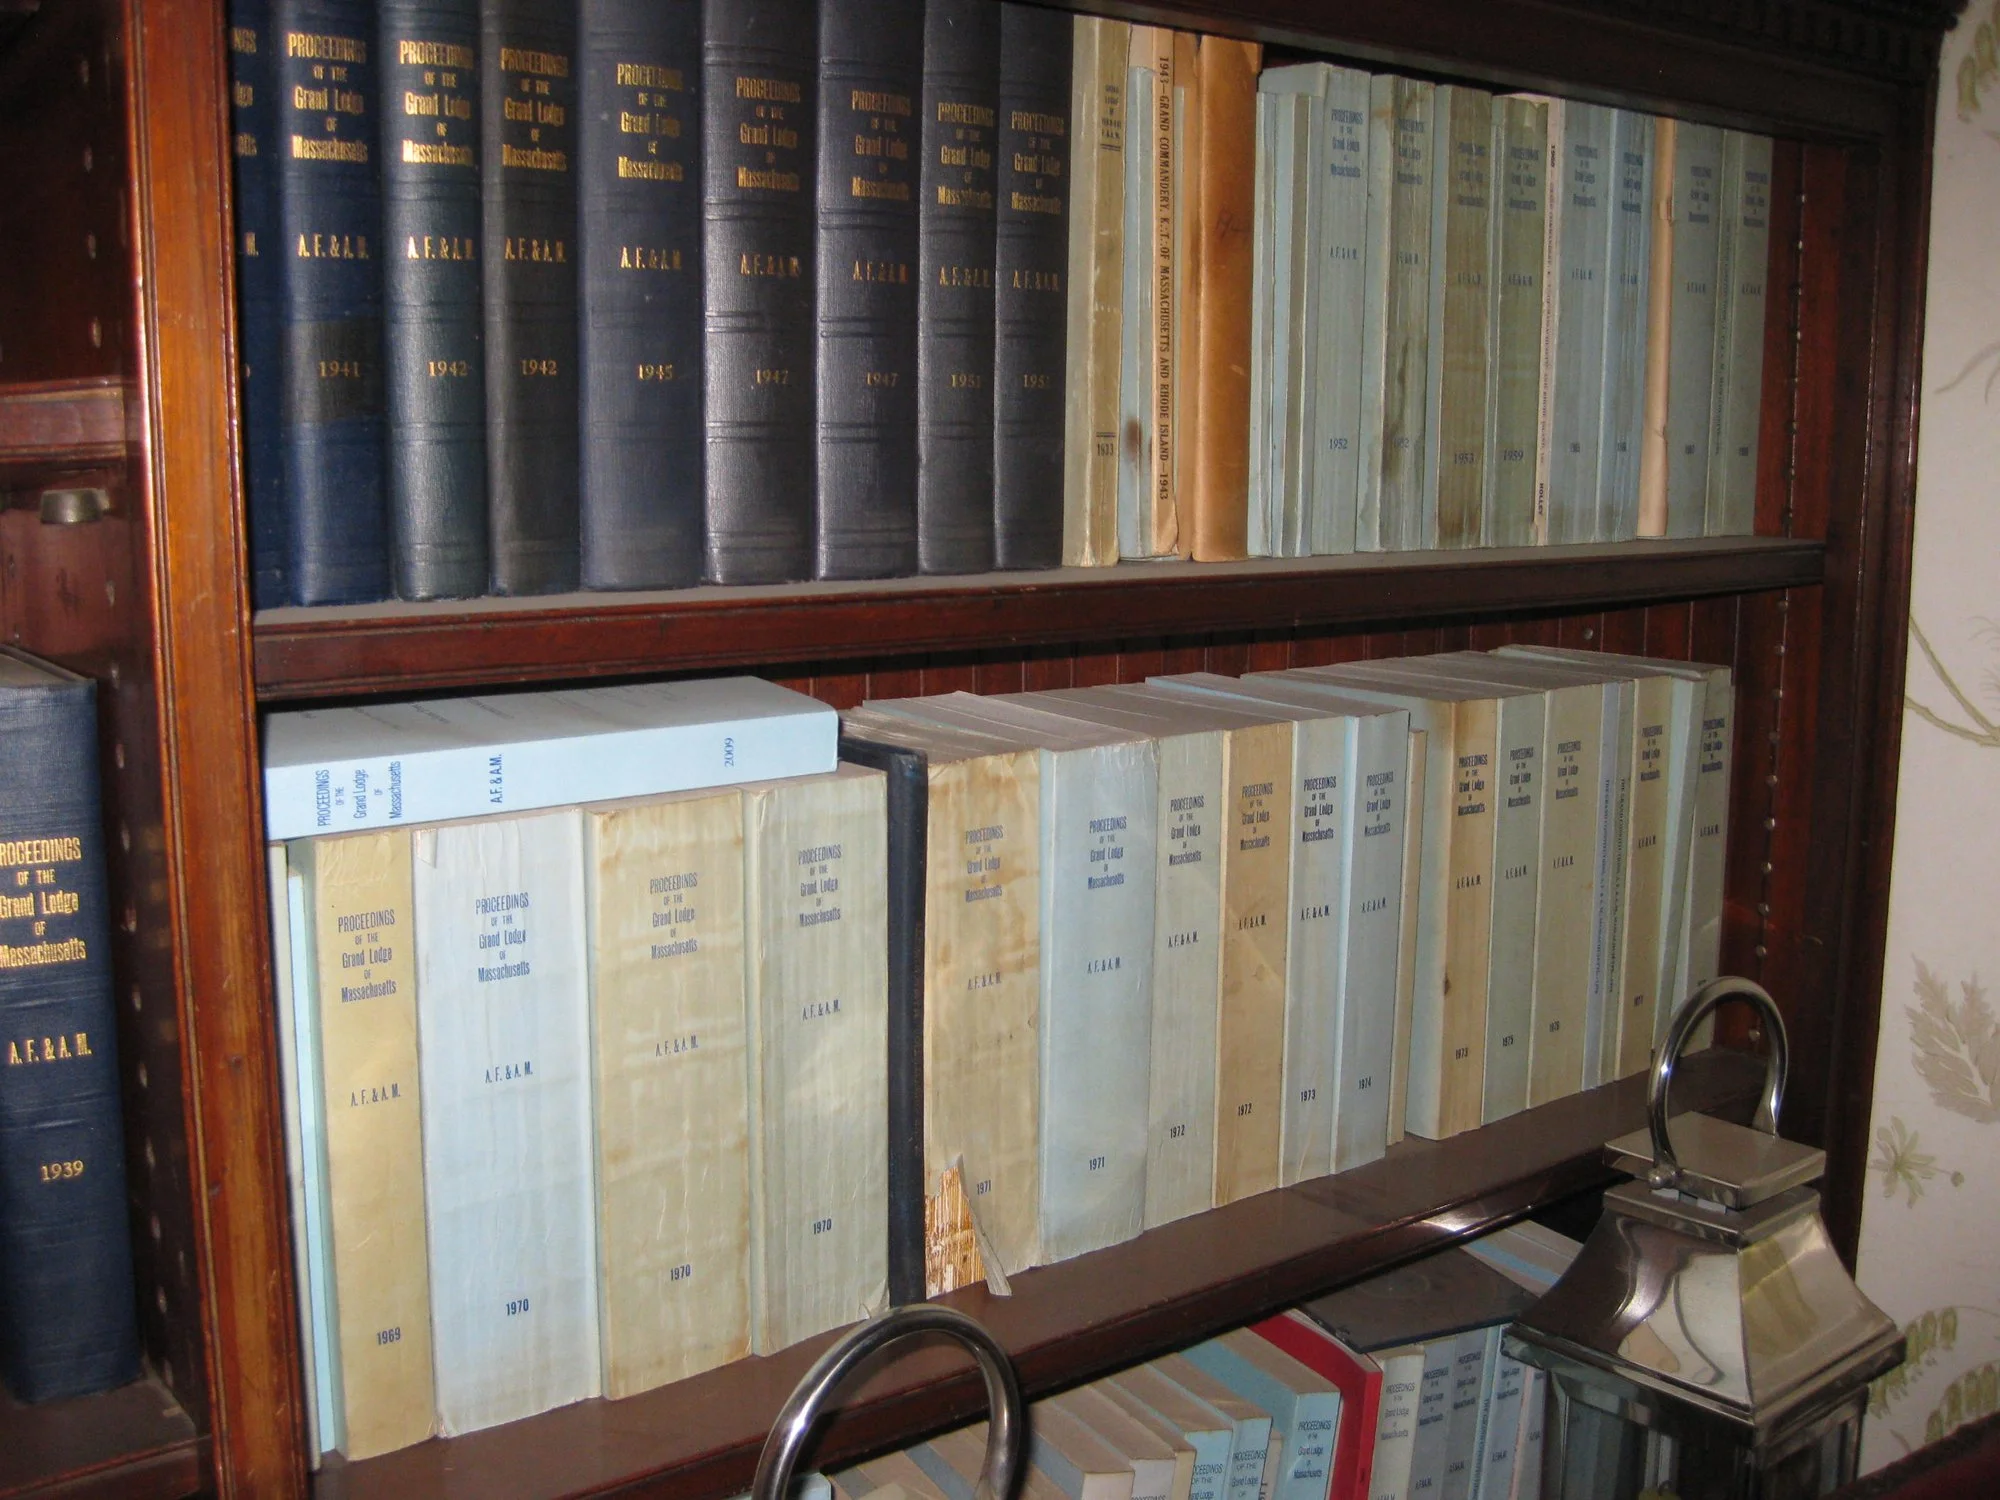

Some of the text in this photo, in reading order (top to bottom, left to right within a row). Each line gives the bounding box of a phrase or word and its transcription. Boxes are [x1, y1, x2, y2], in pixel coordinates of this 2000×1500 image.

[1159, 265, 1169, 352] MASSACHUSETTS
[319, 360, 360, 378] 1941
[429, 360, 467, 378] 1942
[522, 359, 557, 375] 1942
[1159, 357, 1169, 379] AND
[1159, 383, 1169, 418] RHODE
[1329, 438, 1348, 450] 1952
[724, 737, 734, 768] 2009
[388, 760, 402, 819] Massachusetts
[1303, 775, 1336, 792] PROCEEDINGS
[315, 769, 331, 827] PROCEEDINGS
[353, 769, 369, 819] Grand Lodge
[1170, 794, 1204, 812] PROCEEDINGS
[1304, 802, 1333, 817] Grand Lodge
[965, 824, 1004, 844] PROCEEDINGS
[1089, 816, 1127, 834] PROCEEDINGS
[1171, 823, 1201, 840] Grand Lodge
[1302, 827, 1334, 842] Massachusetts
[0, 836, 82, 867] ROCEEDINGS
[799, 844, 842, 865] PROCEEDINGS
[1090, 846, 1123, 862] Grand Lodge
[1168, 849, 1201, 866] Massachusetts
[967, 855, 1000, 874] Grand Lodge
[17, 868, 56, 886] OF THE
[650, 871, 698, 895] PROCEEDINGS
[1088, 872, 1124, 890] Massachusetts
[801, 877, 838, 897] Grand Lodge
[965, 884, 1003, 903] Massachusetts
[0, 889, 79, 919] Grand Lodge
[475, 892, 529, 915] PROCEEDINGS
[338, 908, 395, 933] PROCEEDINGS
[652, 906, 695, 928] Grand Lodge
[799, 907, 841, 927] Massachusetts
[34, 921, 47, 936] OF
[479, 928, 526, 949] Grand Lodge
[342, 946, 392, 968] Grand Lodge
[651, 938, 698, 959] Massachusetts
[478, 960, 530, 982] Massachusetts
[341, 979, 397, 1004] Massachusetts
[1300, 1088, 1316, 1102] 1973
[1238, 1103, 1252, 1117] 1972
[1170, 1124, 1185, 1139] 1972
[41, 1160, 84, 1181] 1939
[1089, 1156, 1104, 1170] 1971
[976, 1179, 991, 1195] 1971
[813, 1218, 832, 1235] 1970
[670, 1264, 692, 1281] 1970
[506, 1298, 529, 1316] 1970
[376, 1326, 401, 1346] 1969
